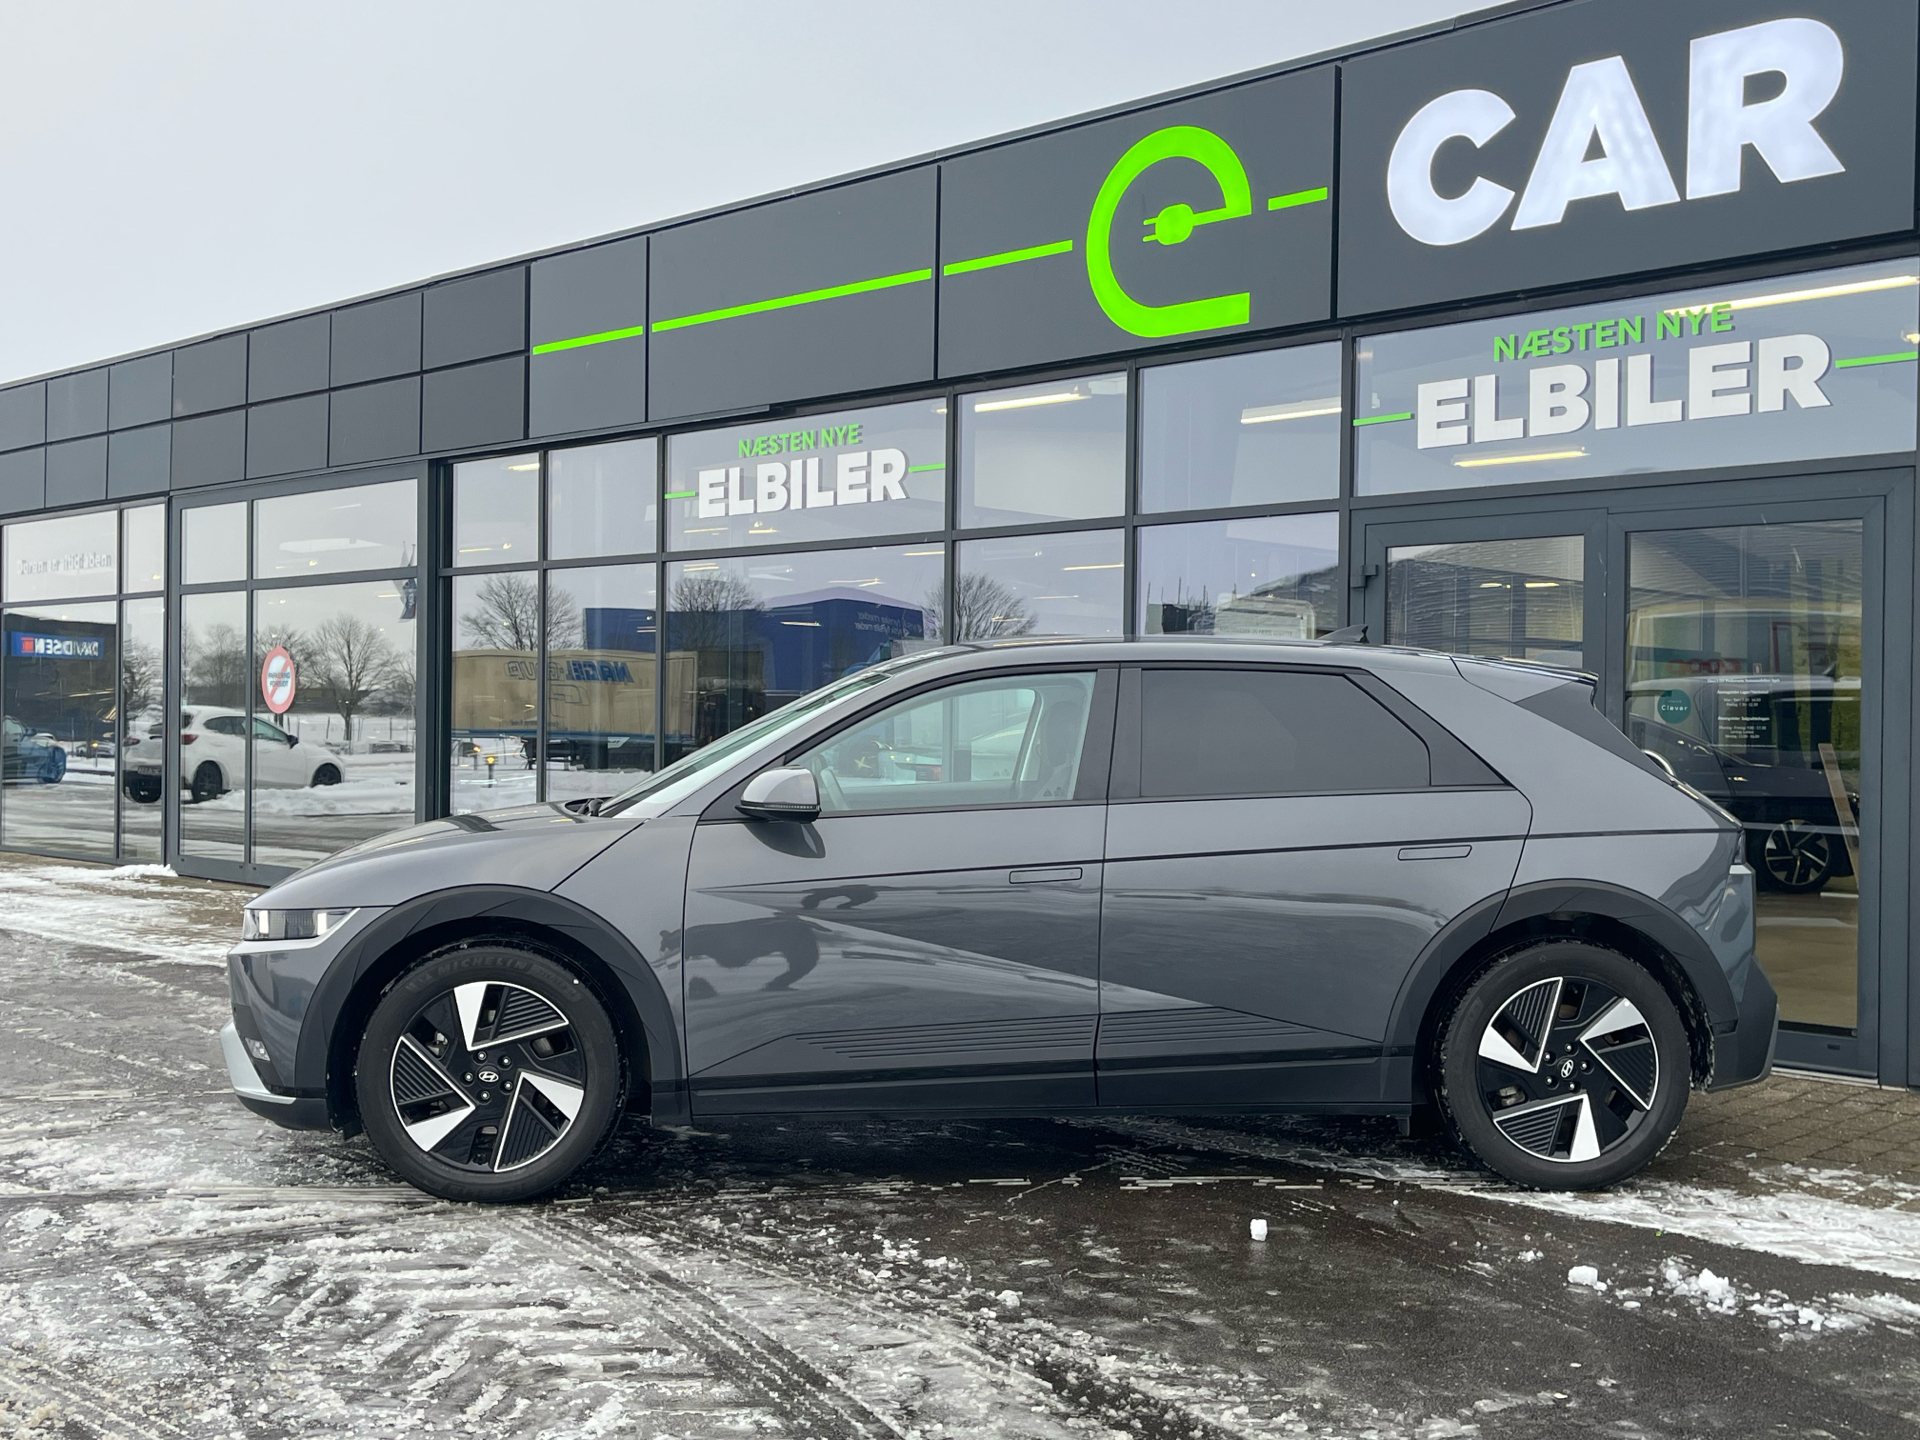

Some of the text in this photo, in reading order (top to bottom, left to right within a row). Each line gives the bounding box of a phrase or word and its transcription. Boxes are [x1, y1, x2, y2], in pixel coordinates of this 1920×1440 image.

[1387, 17, 1846, 246] CAR
[1493, 303, 1734, 362] NÆSTEN NYE
[1417, 333, 1833, 450] ELBILER
[738, 423, 861, 458] NÆSTEN NYE
[698, 447, 909, 519] ELBILER
[1661, 704, 1688, 712] Clever
[437, 956, 528, 976] MICHELIN
